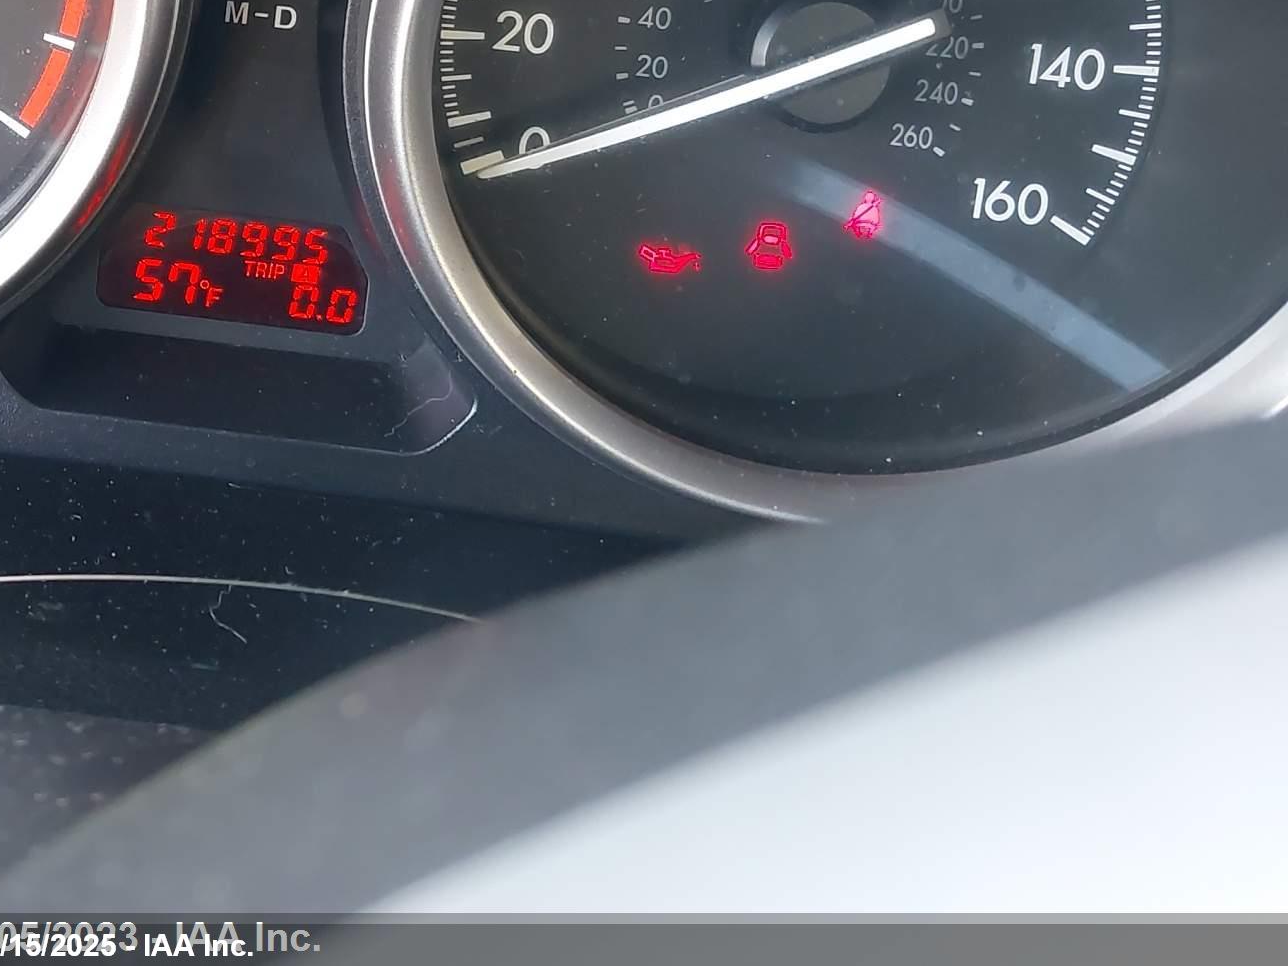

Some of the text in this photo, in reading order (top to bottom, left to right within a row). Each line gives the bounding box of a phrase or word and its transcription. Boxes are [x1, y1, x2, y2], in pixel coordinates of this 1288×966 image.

[492, 10, 554, 55] 20
[637, 6, 672, 30] 40
[635, 54, 669, 79] 20
[1029, 43, 1106, 91] 140
[914, 79, 958, 106] 240
[889, 123, 933, 150] 260
[972, 177, 1049, 226] 160
[143, 211, 329, 265] 218995
[244, 260, 286, 280] TRIP
[288, 284, 358, 324] 0.0
